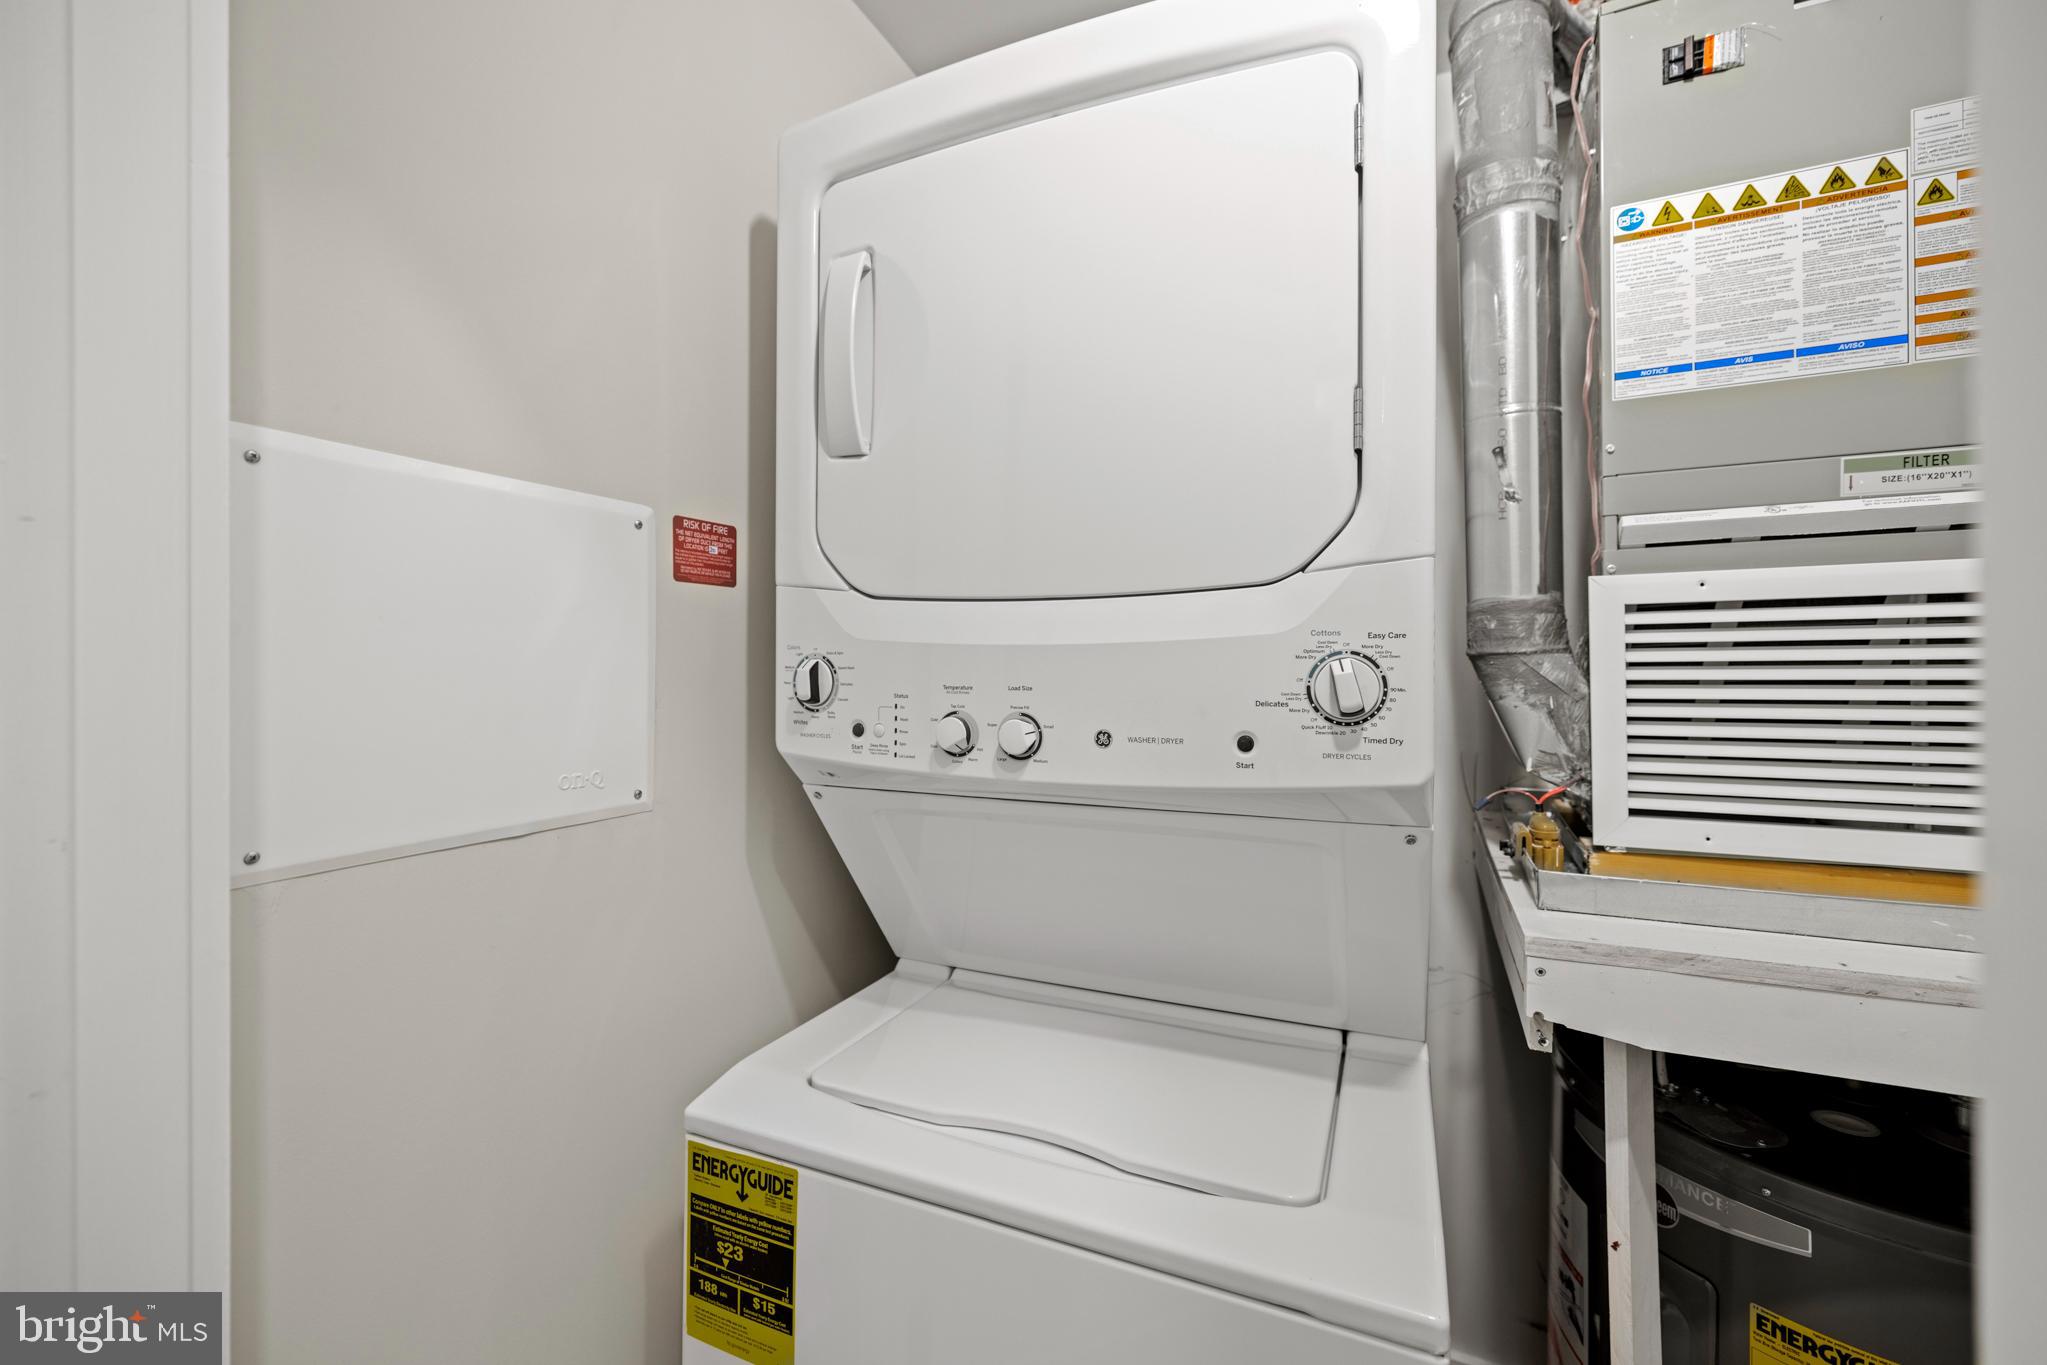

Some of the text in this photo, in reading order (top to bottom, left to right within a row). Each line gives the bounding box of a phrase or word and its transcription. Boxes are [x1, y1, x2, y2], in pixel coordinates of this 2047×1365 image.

[1827, 186, 1888, 202] ADVERTENCIA
[1718, 206, 1783, 223] AVERTISSEMENT
[1640, 227, 1674, 239] WARNING
[1838, 341, 1865, 351] AVISO
[1735, 356, 1754, 364] AVIS
[1641, 367, 1669, 377] NOTICE
[1903, 454, 1950, 469] FILTER
[683, 519, 728, 536] RISK OF FIRE
[1368, 632, 1386, 640] Easy
[1363, 737, 1404, 746] Timed Dry
[693, 1152, 794, 1201] ENERGYGUIDE
[1657, 1200, 1676, 1221] eem
[717, 1241, 744, 1262] $23
[699, 1279, 718, 1296] 188
[753, 1297, 776, 1315] $15
